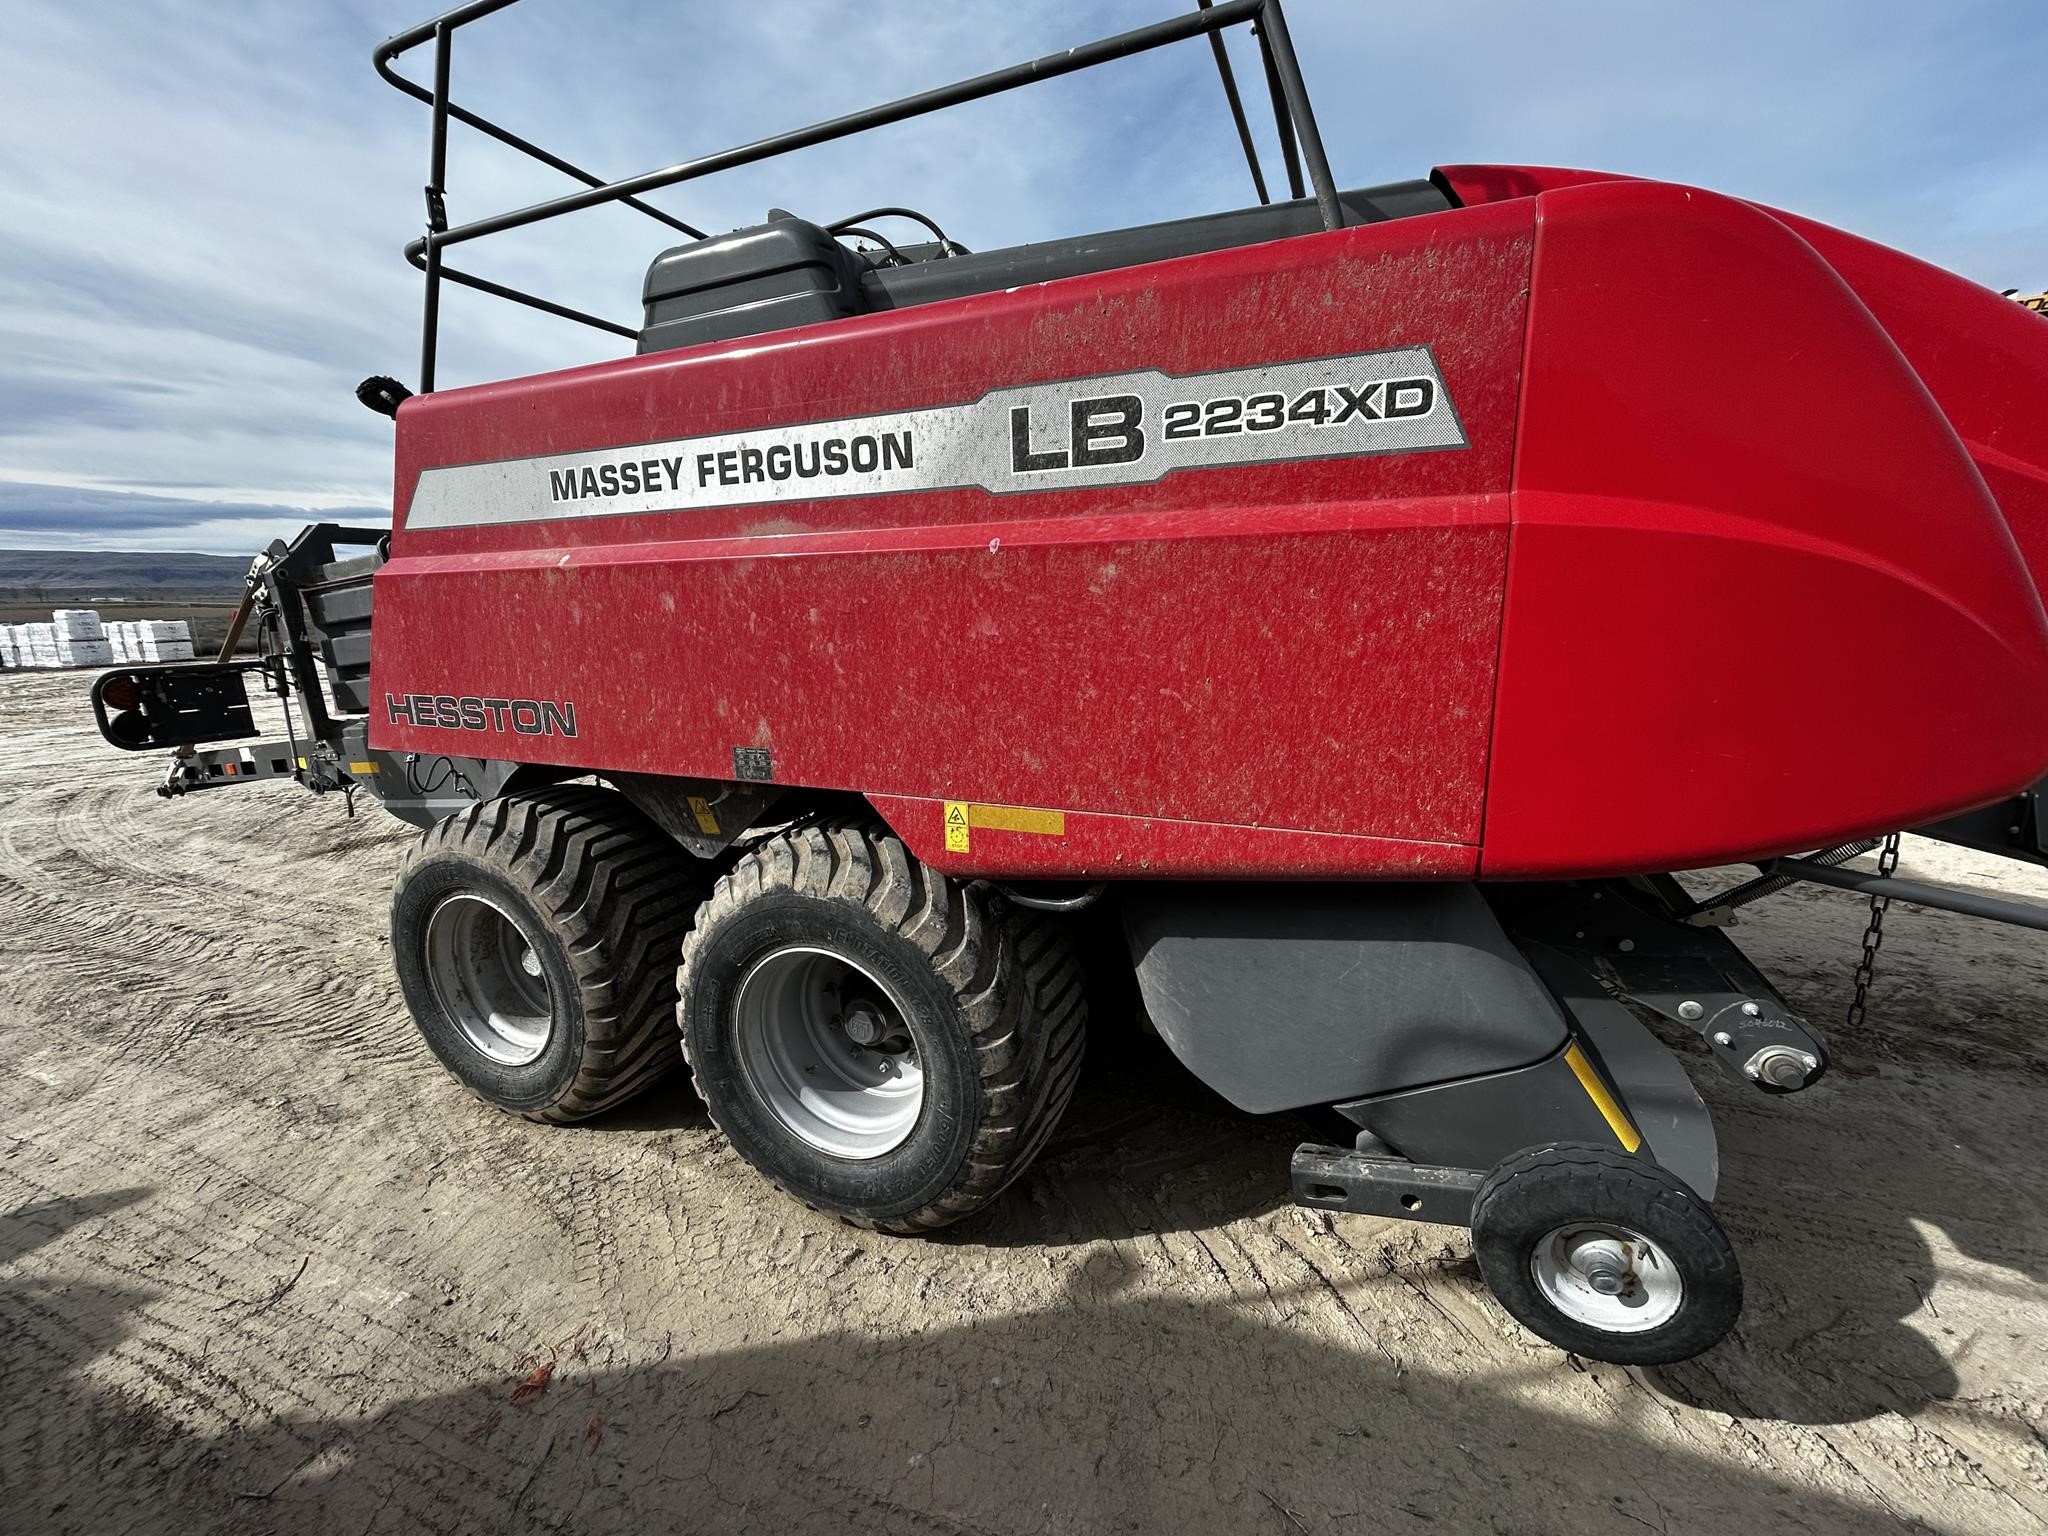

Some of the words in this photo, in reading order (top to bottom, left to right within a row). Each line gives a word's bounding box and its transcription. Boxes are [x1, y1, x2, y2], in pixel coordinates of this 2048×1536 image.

[1010, 394, 1146, 474] LB
[1163, 378, 1437, 441] 2234XD
[549, 456, 683, 501] MASSEY
[696, 430, 914, 488] FERGUSON
[385, 692, 578, 738] HESSTON
